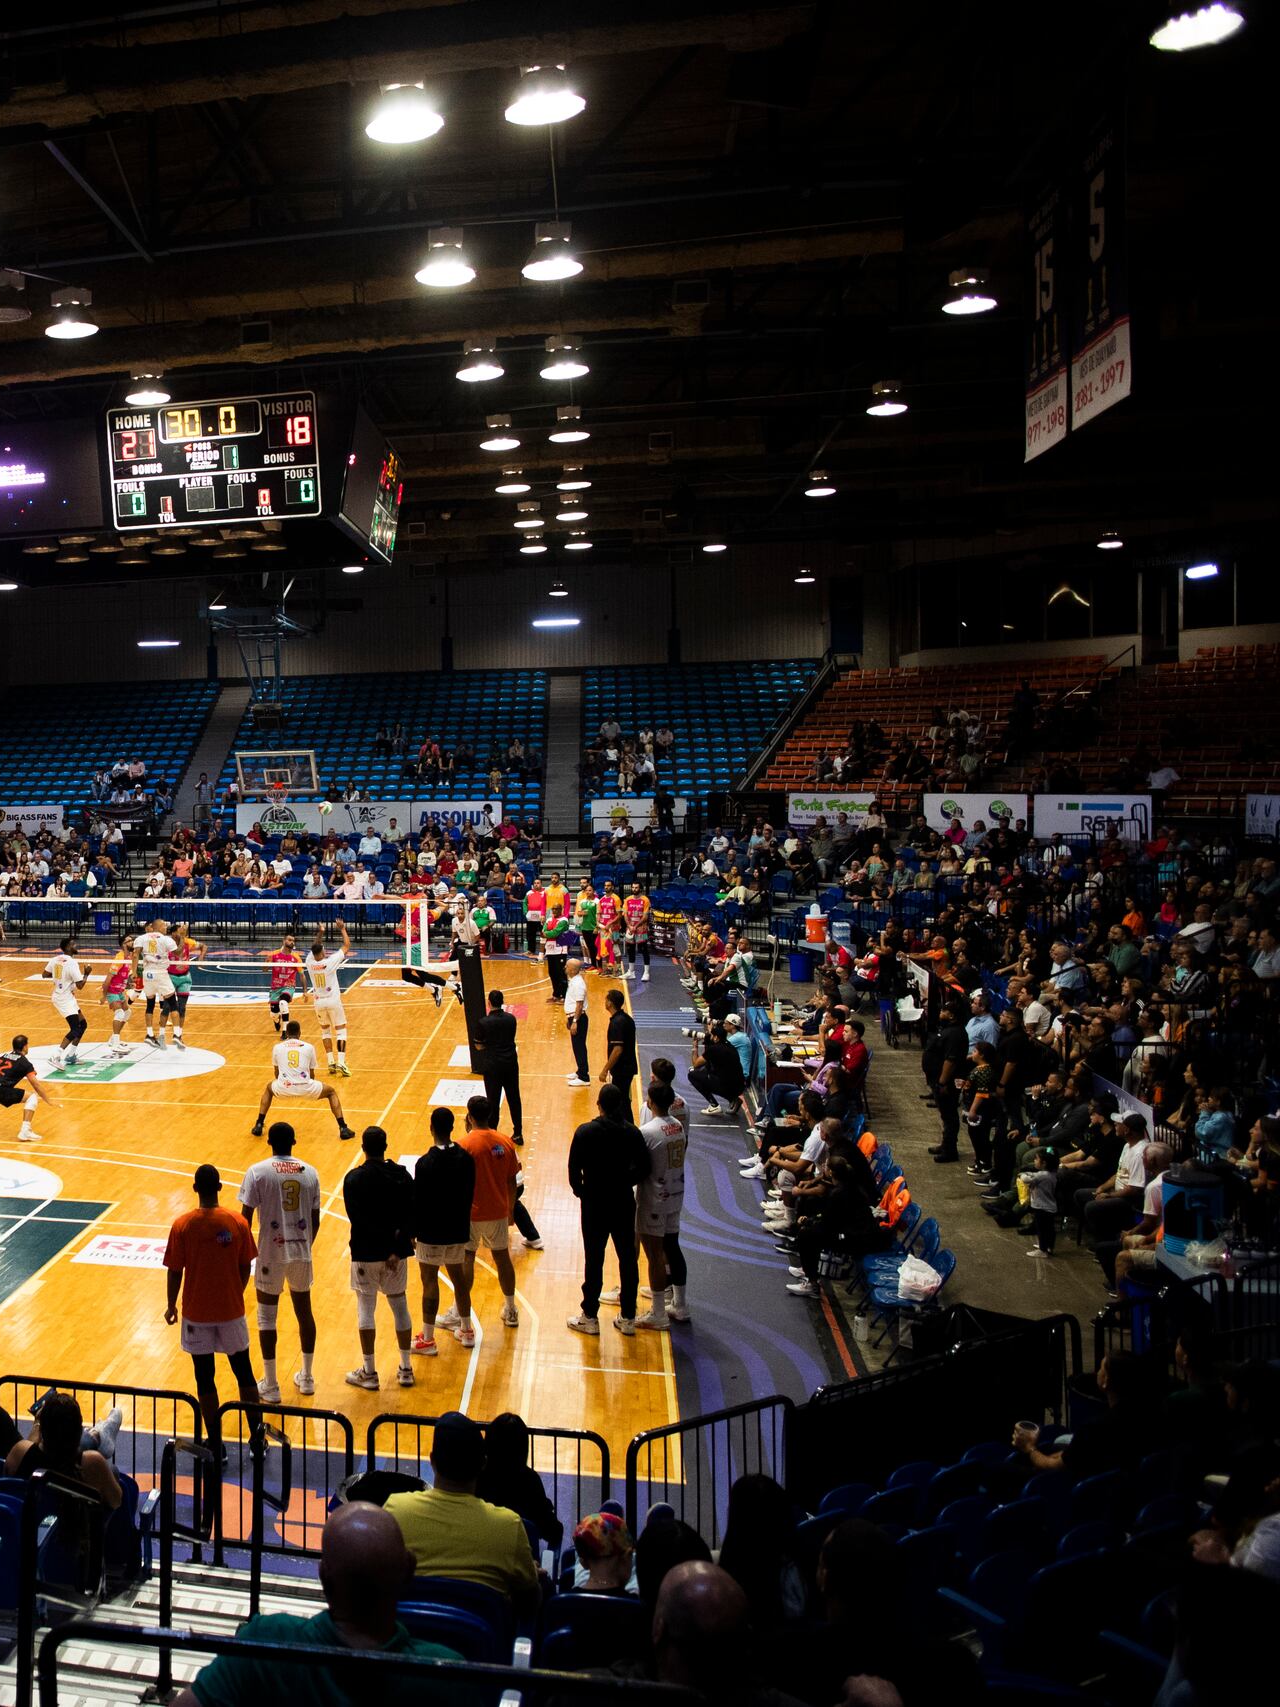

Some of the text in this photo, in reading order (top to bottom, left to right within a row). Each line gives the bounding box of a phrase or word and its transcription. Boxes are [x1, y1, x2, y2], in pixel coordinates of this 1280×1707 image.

[1087, 167, 1106, 263] 5
[1033, 236, 1056, 322] 15
[263, 400, 313, 417] VISITOR
[115, 414, 151, 430] HOME
[286, 415, 312, 444] 18
[121, 431, 155, 460] 21
[186, 448, 220, 462] PERIOD
[264, 452, 295, 464] BONUS
[132, 462, 163, 475] BONUS
[284, 468, 314, 480] FOULS
[179, 476, 213, 489] PLAYER
[227, 473, 257, 485] FOULS
[117, 482, 145, 493] FOULS
[300, 480, 313, 502] 0
[132, 493, 144, 514] 0
[259, 489, 270, 506] 0
[158, 512, 176, 523] TOL
[256, 505, 274, 516] TOL
[20, 813, 36, 821] ASS
[1081, 815, 1124, 831] RSM
[261, 822, 307, 830] ESTWAY
[288, 1049, 299, 1068] 9
[281, 1180, 301, 1211] 3
